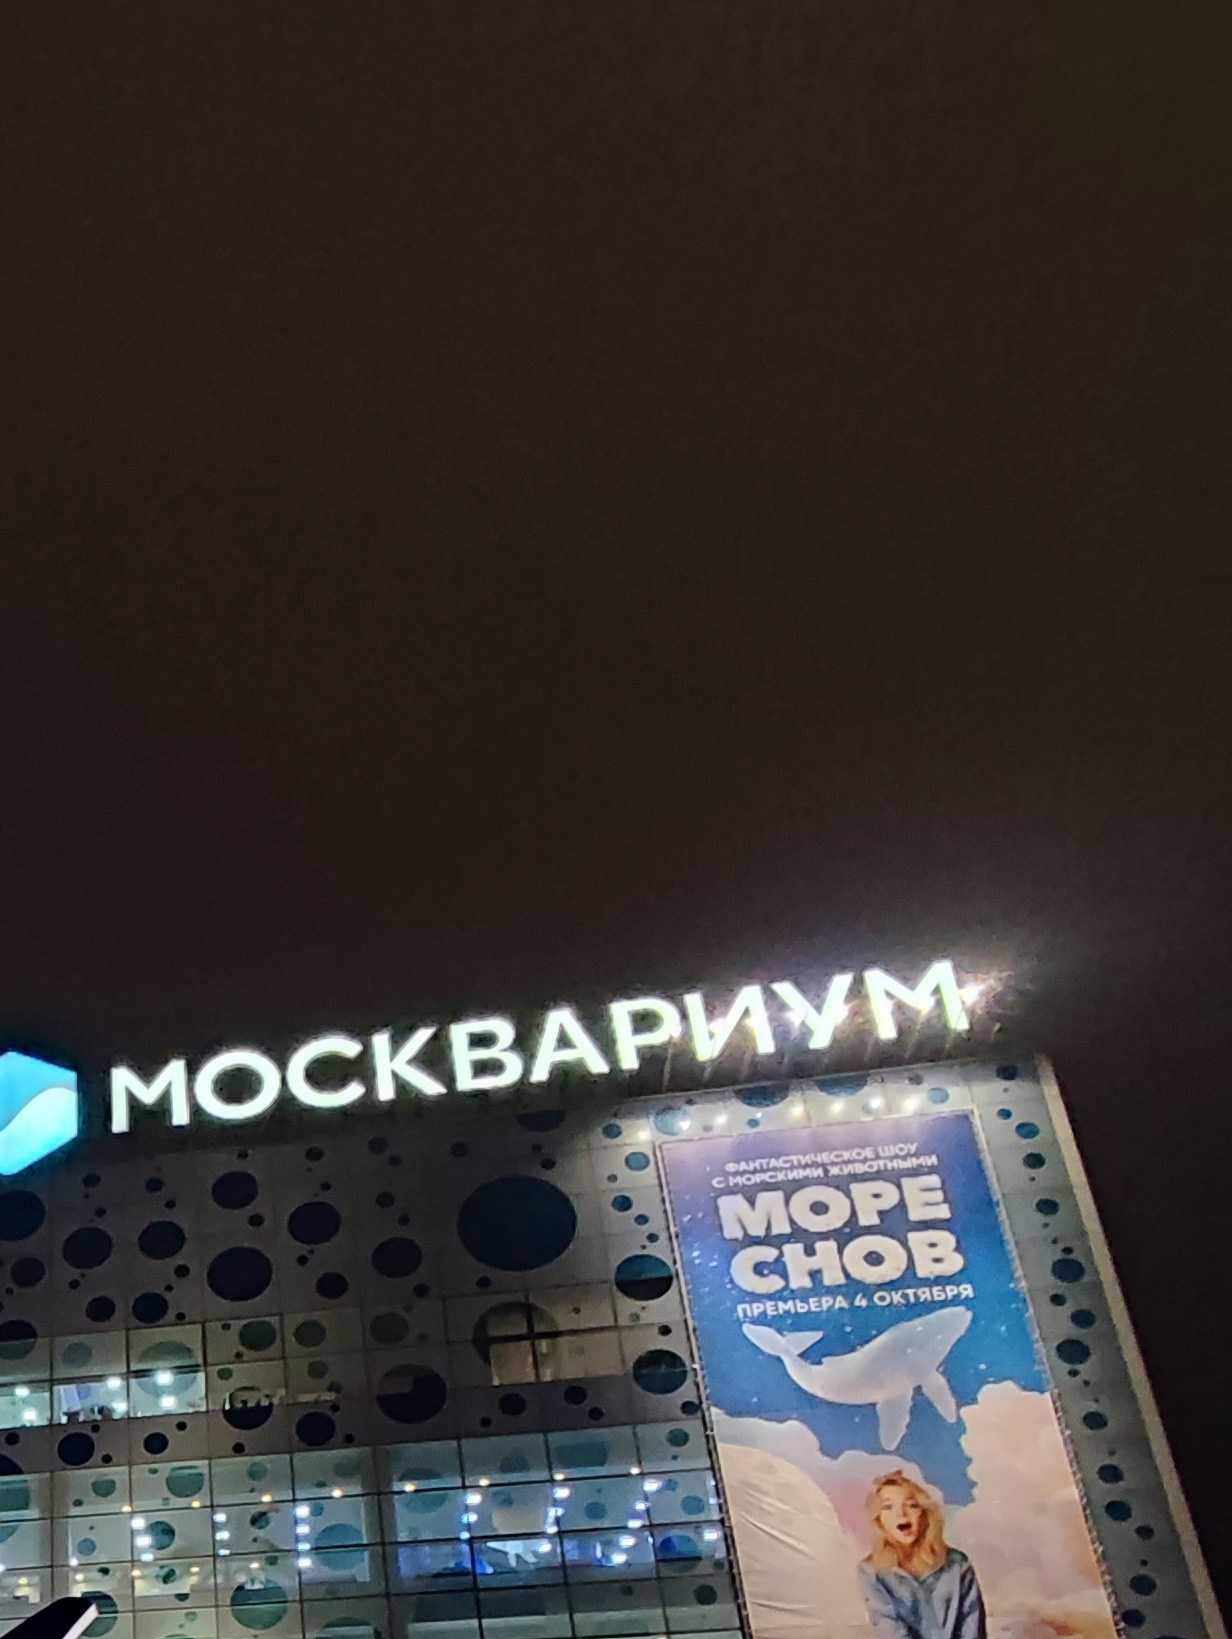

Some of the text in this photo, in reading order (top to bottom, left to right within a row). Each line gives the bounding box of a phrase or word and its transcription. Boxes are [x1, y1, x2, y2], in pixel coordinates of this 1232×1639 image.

[108, 958, 973, 1135] МОСКВАРИУМ
[711, 1153, 939, 1189] С МОРСКИМИ ЖИВОТНЫМИ
[725, 1142, 918, 1173] ФАНТАСТИЧЕСКОЕ ШОУ
[716, 1174, 952, 1242] МОРЕ
[729, 1228, 965, 1295] СНОВ
[736, 1283, 976, 1320] ПРЕМЬЕРА 4 ОКТЯБРЯ
